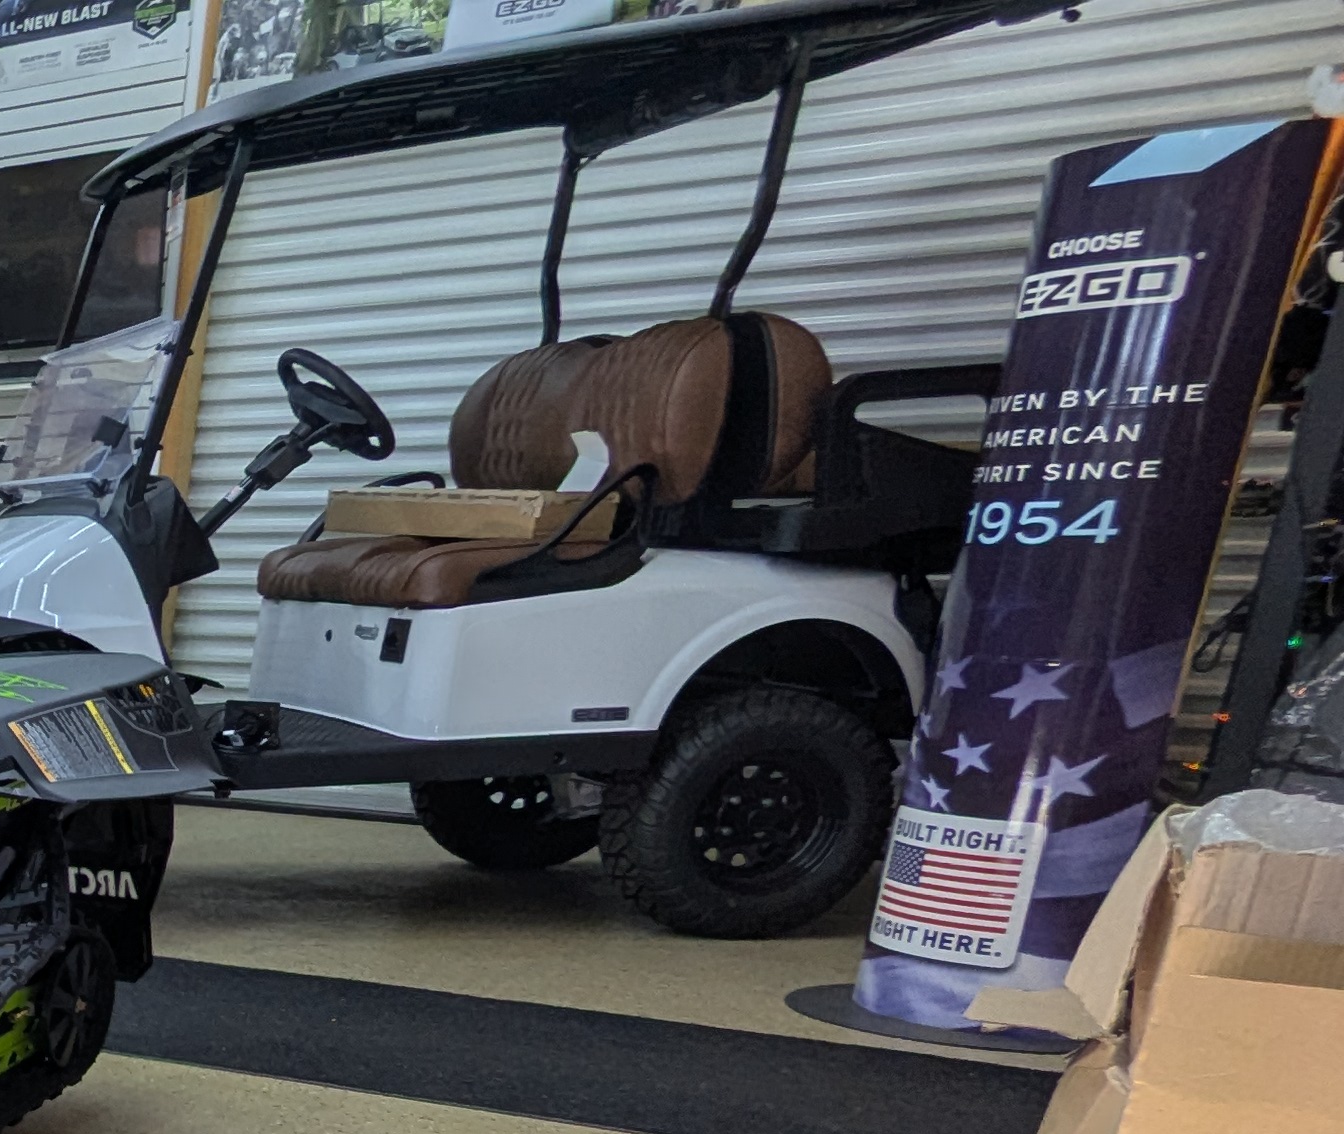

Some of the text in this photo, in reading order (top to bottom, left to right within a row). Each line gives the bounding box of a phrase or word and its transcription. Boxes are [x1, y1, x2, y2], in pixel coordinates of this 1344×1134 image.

[61, 1, 113, 26] BLAST
[1047, 228, 1145, 260] CHOOSE
[1018, 261, 1184, 315] EZGO
[1058, 388, 1107, 409] BY
[1126, 383, 1208, 405] THE
[983, 424, 1143, 449] AMERICAN
[1042, 460, 1162, 482] SINCE
[965, 499, 1120, 545] 1954
[896, 818, 1028, 854] BUILT RIGHT.
[873, 915, 1002, 957] RIGHT HERE.
